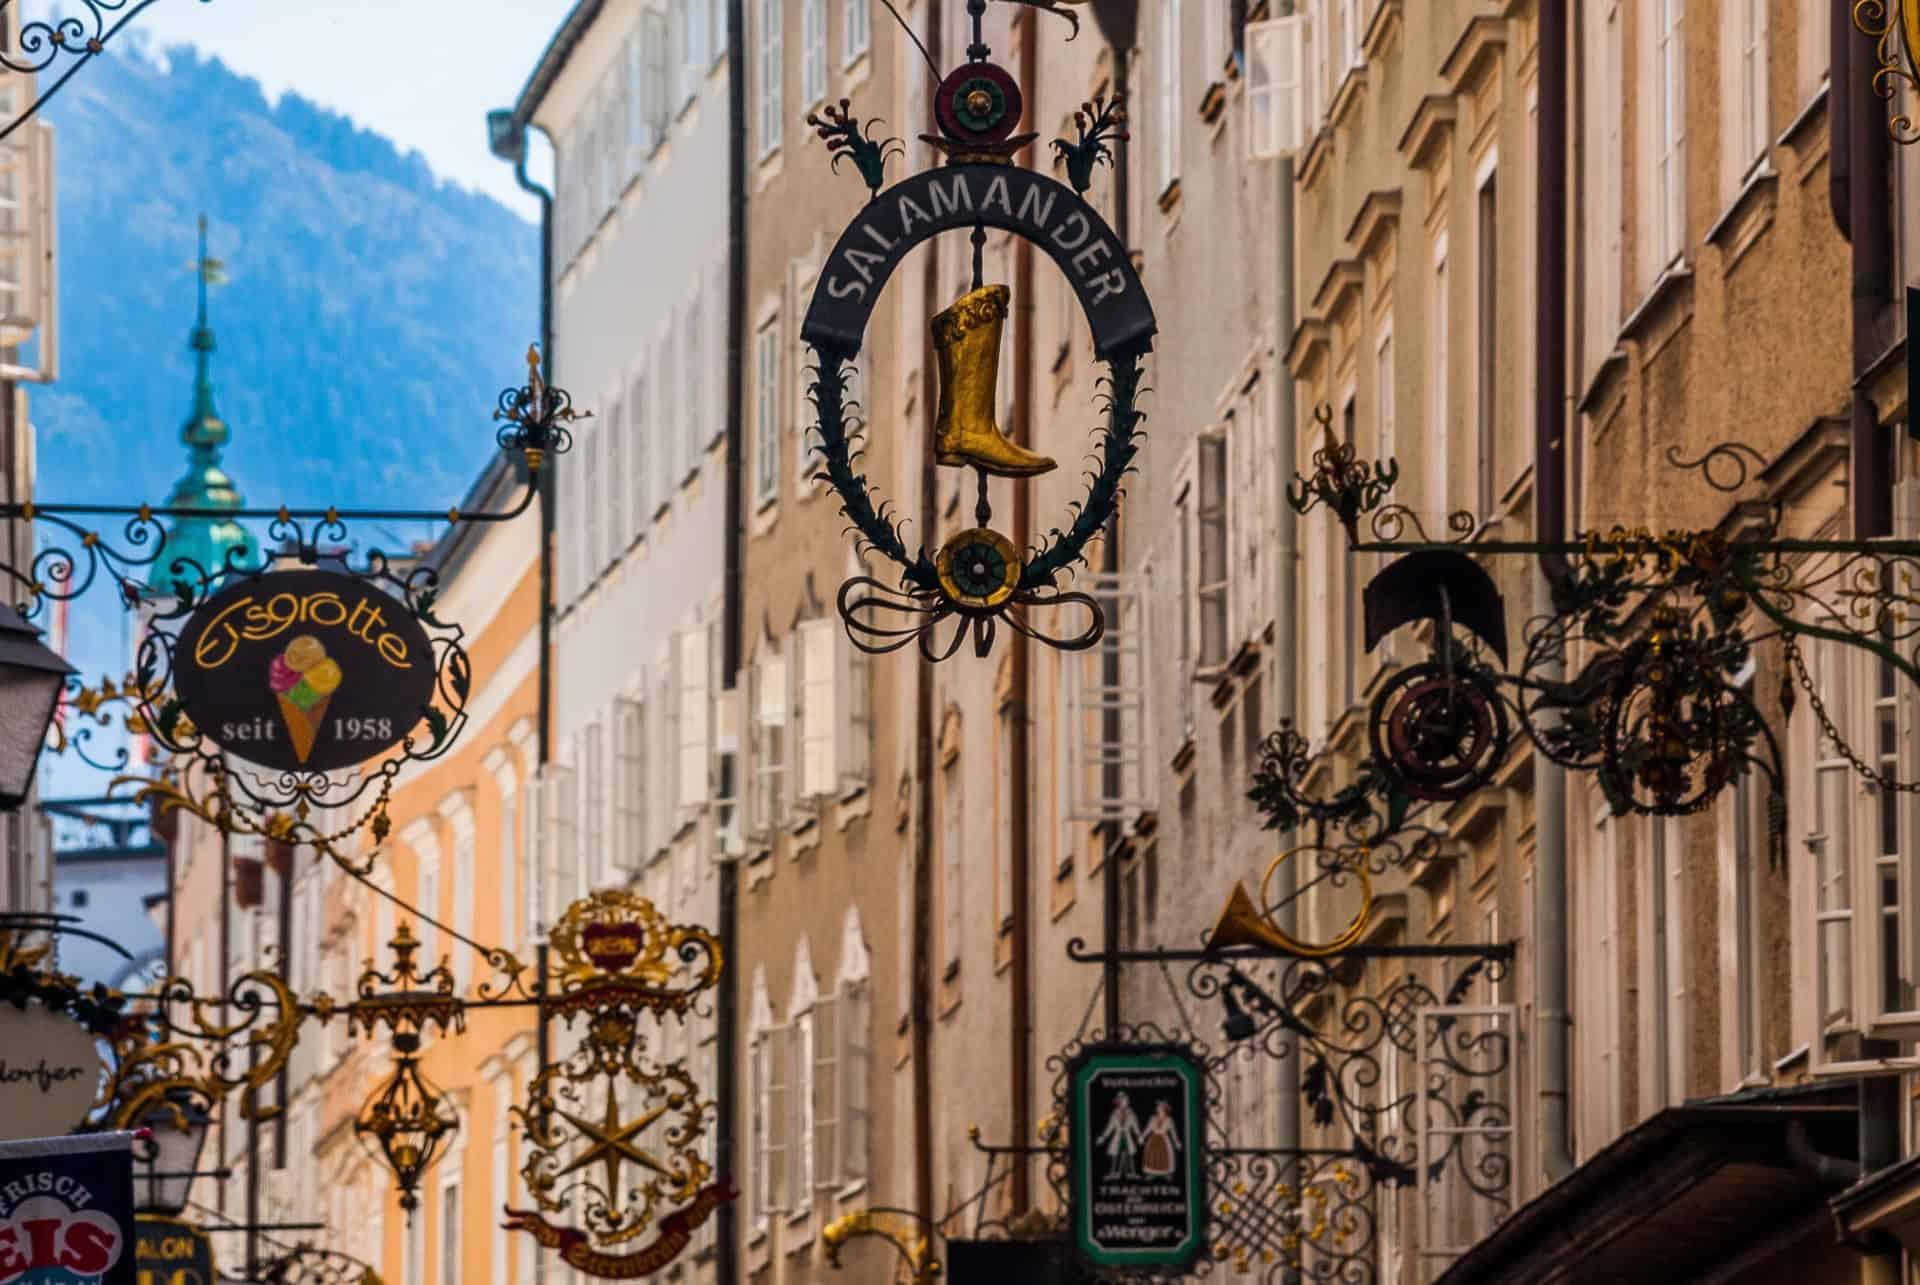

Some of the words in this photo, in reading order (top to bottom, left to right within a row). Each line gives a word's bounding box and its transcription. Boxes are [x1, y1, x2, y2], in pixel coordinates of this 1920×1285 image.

[827, 173, 1127, 305] SALAMANDER
[195, 592, 413, 669] Eisgrotte
[222, 718, 275, 741] seit
[333, 718, 393, 741] 1958
